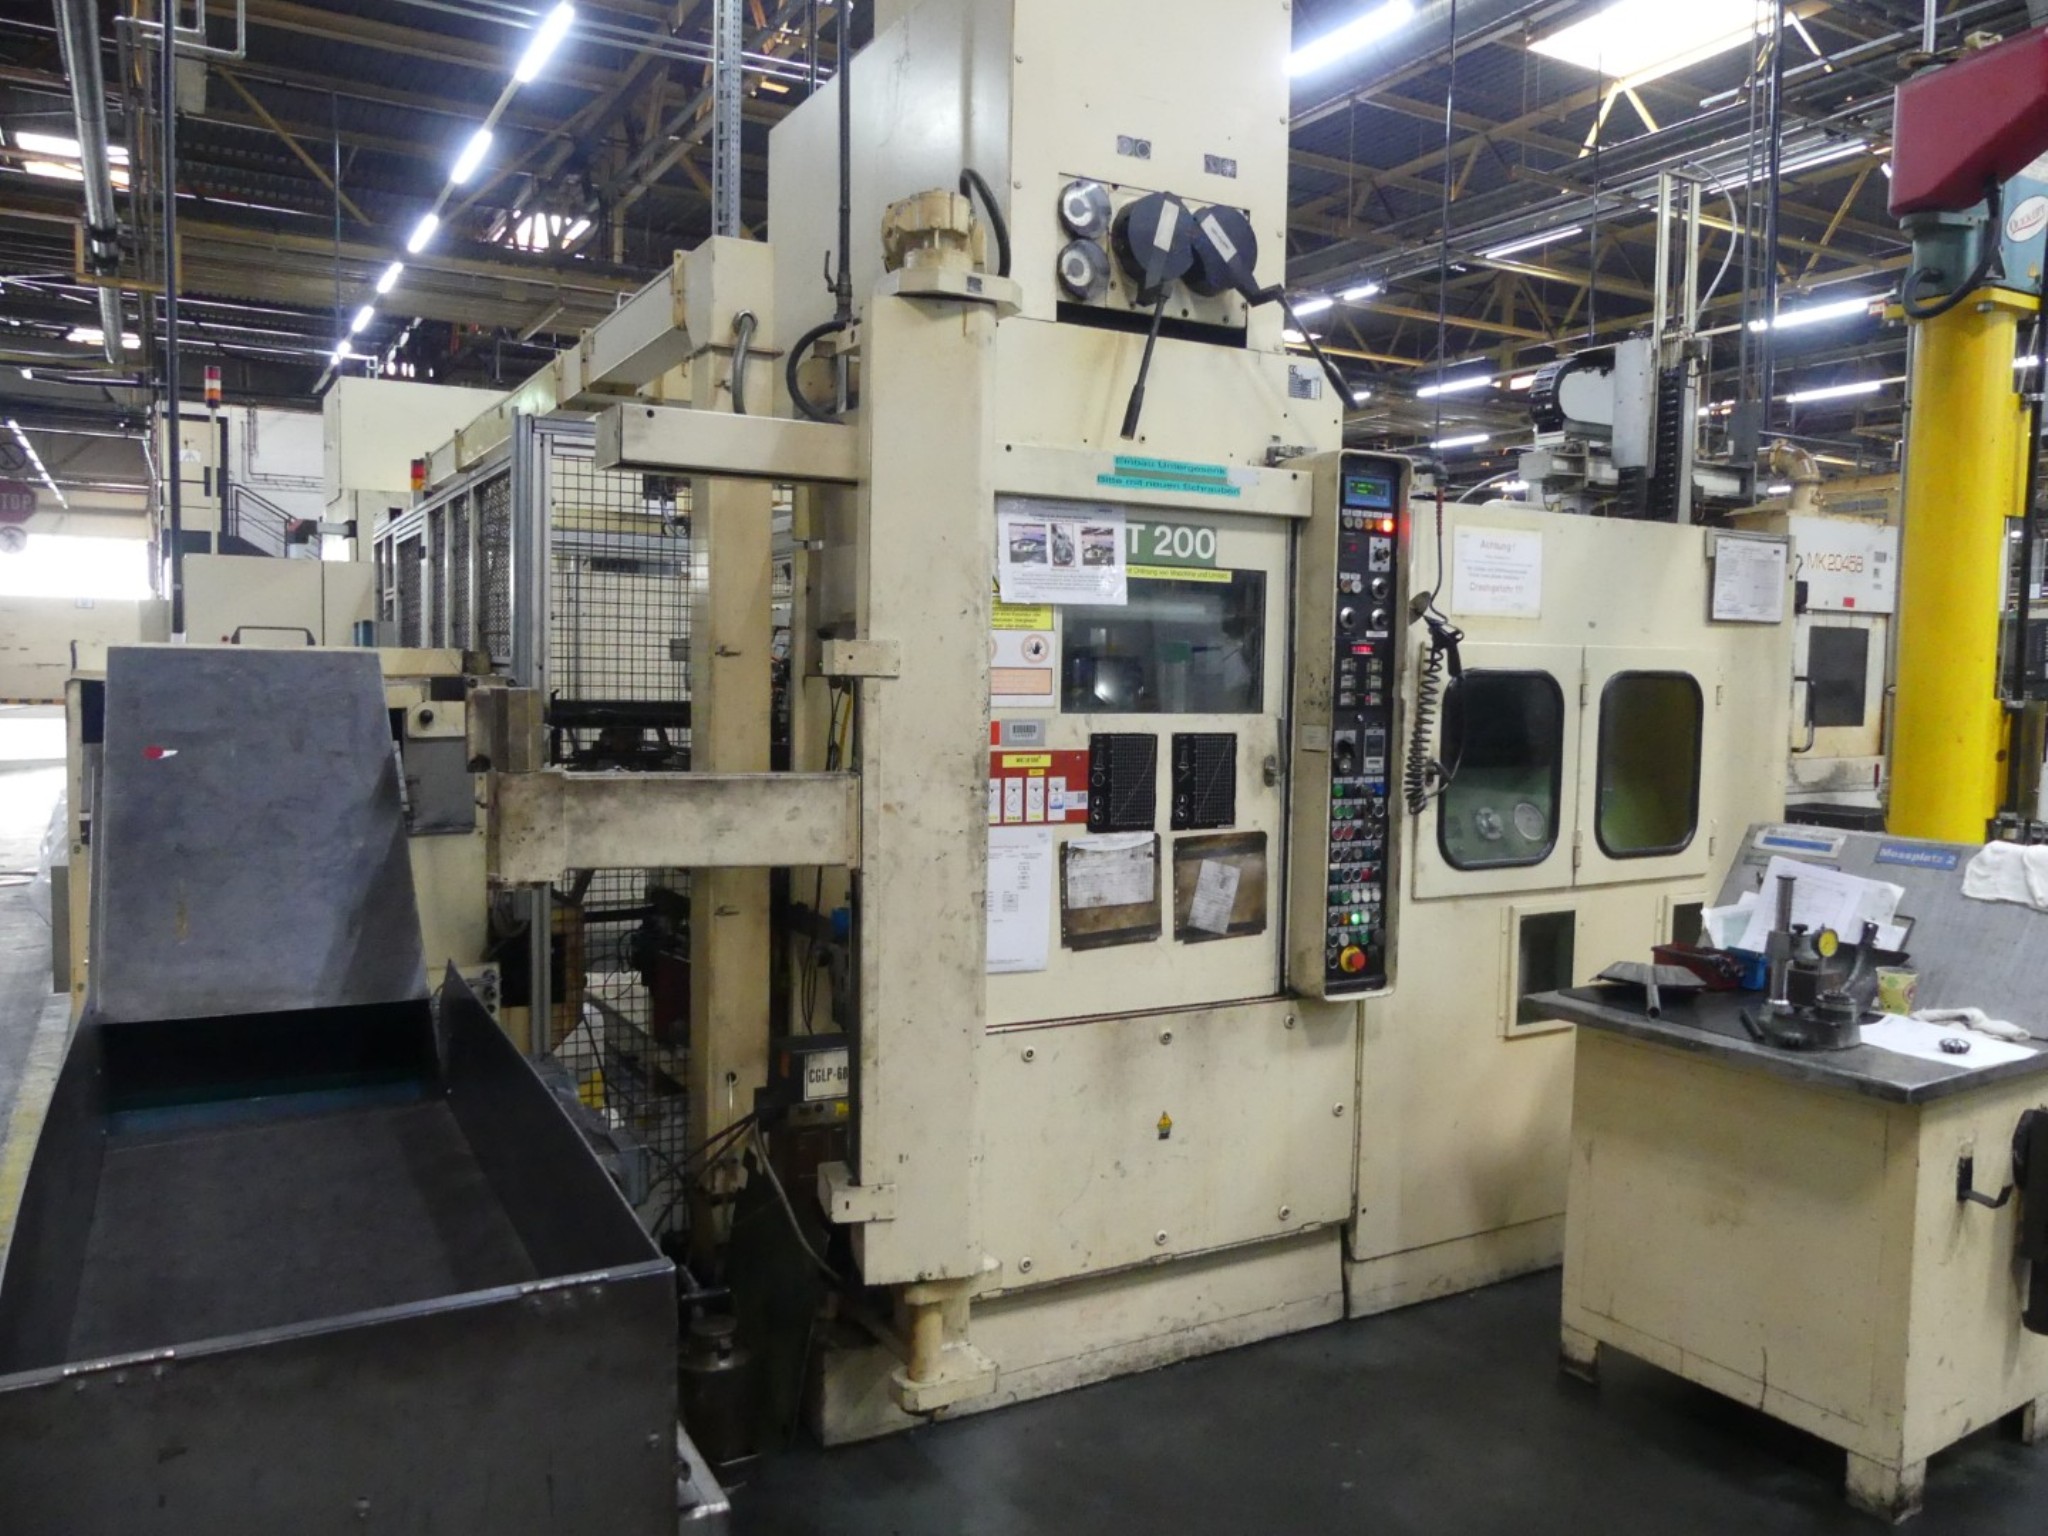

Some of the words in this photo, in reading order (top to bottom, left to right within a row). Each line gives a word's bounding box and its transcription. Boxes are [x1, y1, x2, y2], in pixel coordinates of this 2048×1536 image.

[1097, 475, 1123, 484] Bitte
[1125, 478, 1143, 487] mit
[1145, 481, 1180, 490] neuen
[1183, 483, 1241, 496] Schrauben
[0, 494, 31, 510] TOP
[1153, 525, 1216, 560] 200
[1879, 847, 1943, 865] Messplatz
[1946, 854, 1956, 865] 2
